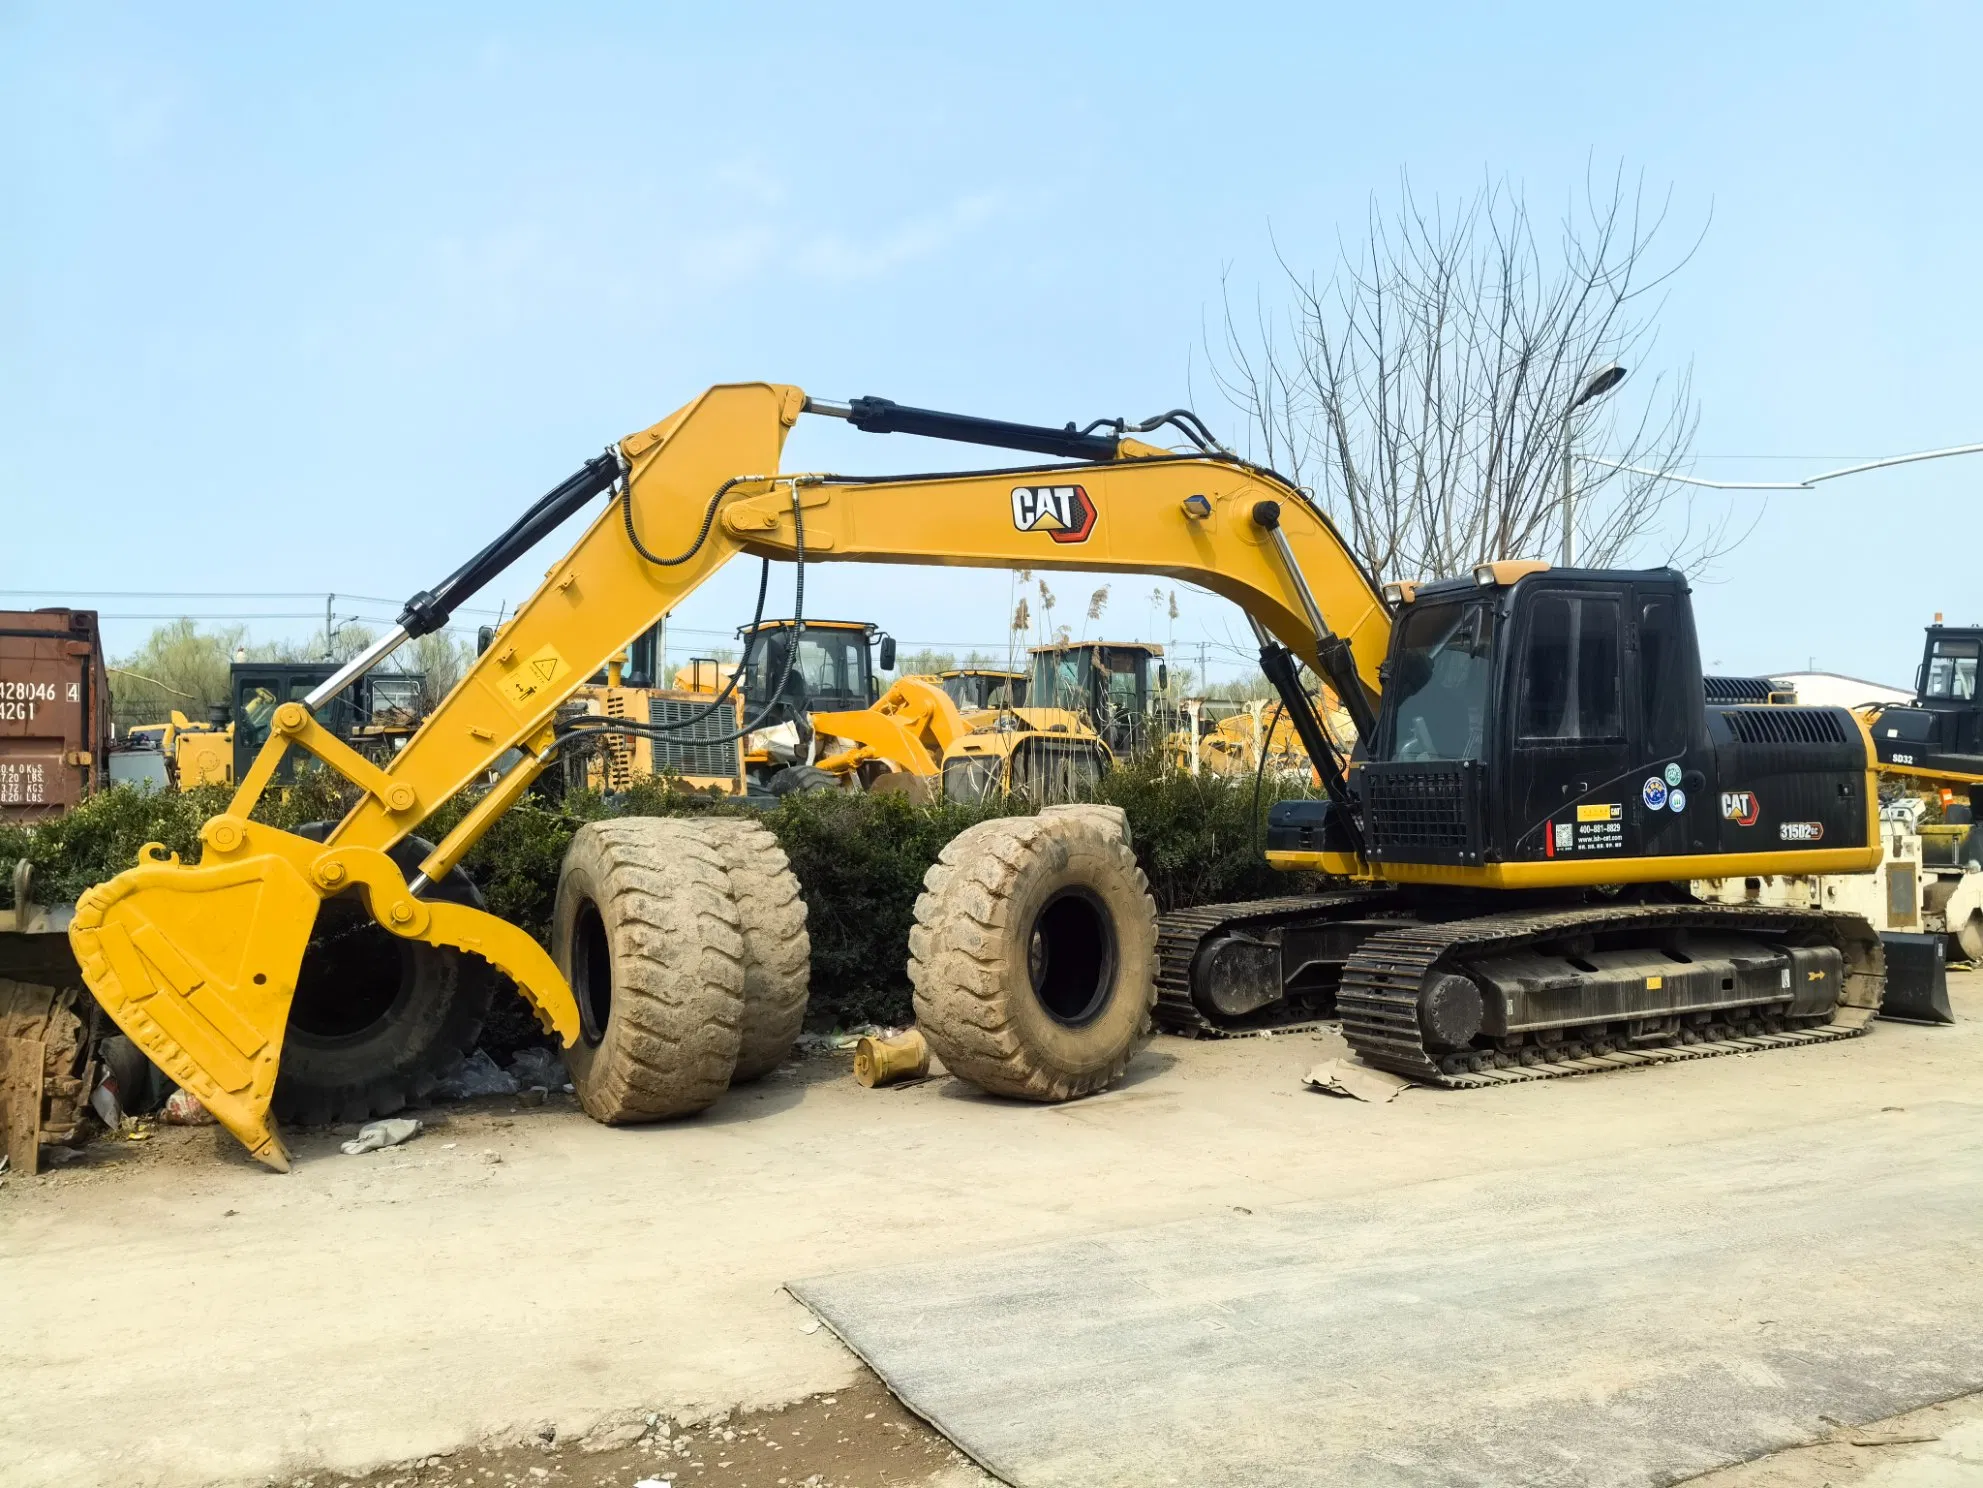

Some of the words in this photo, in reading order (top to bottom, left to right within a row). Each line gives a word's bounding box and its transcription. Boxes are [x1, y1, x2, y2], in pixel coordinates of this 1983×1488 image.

[1012, 487, 1074, 531] CAT
[68, 684, 78, 701] 4
[1892, 753, 1914, 765] SD32
[1610, 807, 1621, 816] CAT
[1721, 793, 1749, 818] CAT
[1780, 823, 1811, 840] 315D2
